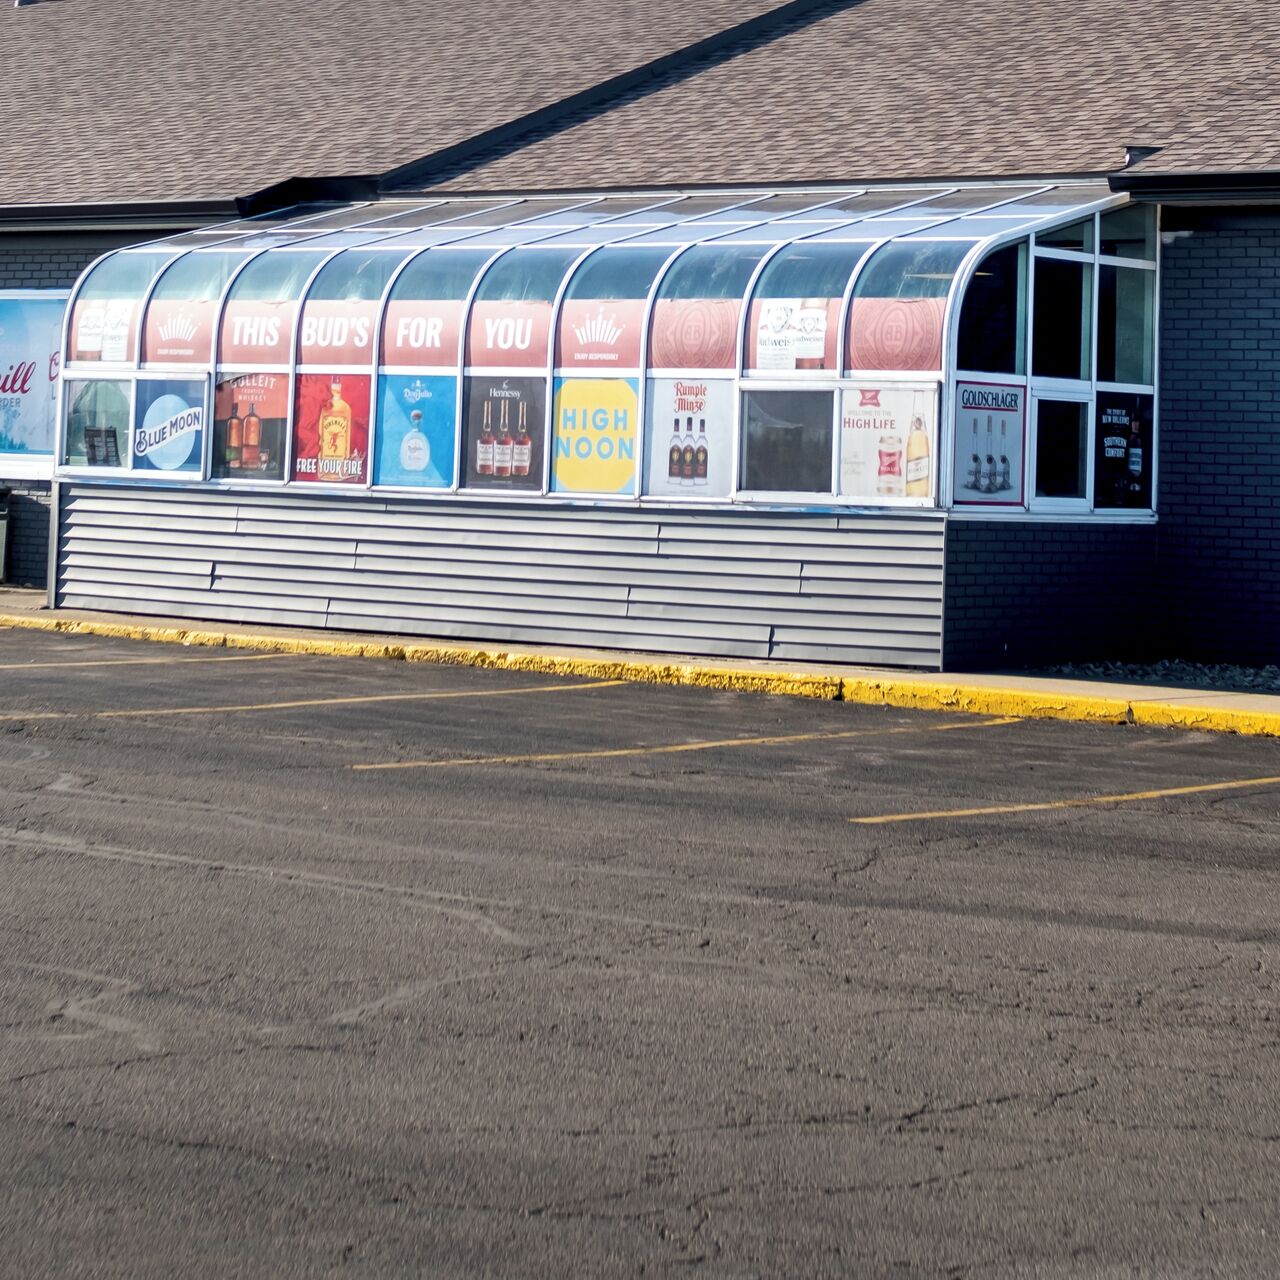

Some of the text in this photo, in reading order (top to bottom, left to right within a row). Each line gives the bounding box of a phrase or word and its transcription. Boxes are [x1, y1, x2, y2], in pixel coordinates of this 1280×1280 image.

[231, 315, 533, 349] THIS BUD'S FOR YOU
[489, 388, 521, 399] Hennessy
[674, 381, 707, 398] Rumple
[961, 389, 1019, 408] GOLDSCHLÄGER
[674, 398, 706, 414] Minze
[562, 408, 628, 430] HIGH
[843, 417, 896, 429] HIGH LIFE
[135, 411, 201, 454] BLUE MOON
[556, 436, 634, 459] NOON
[296, 458, 363, 475] FREE YOUR FIRE
